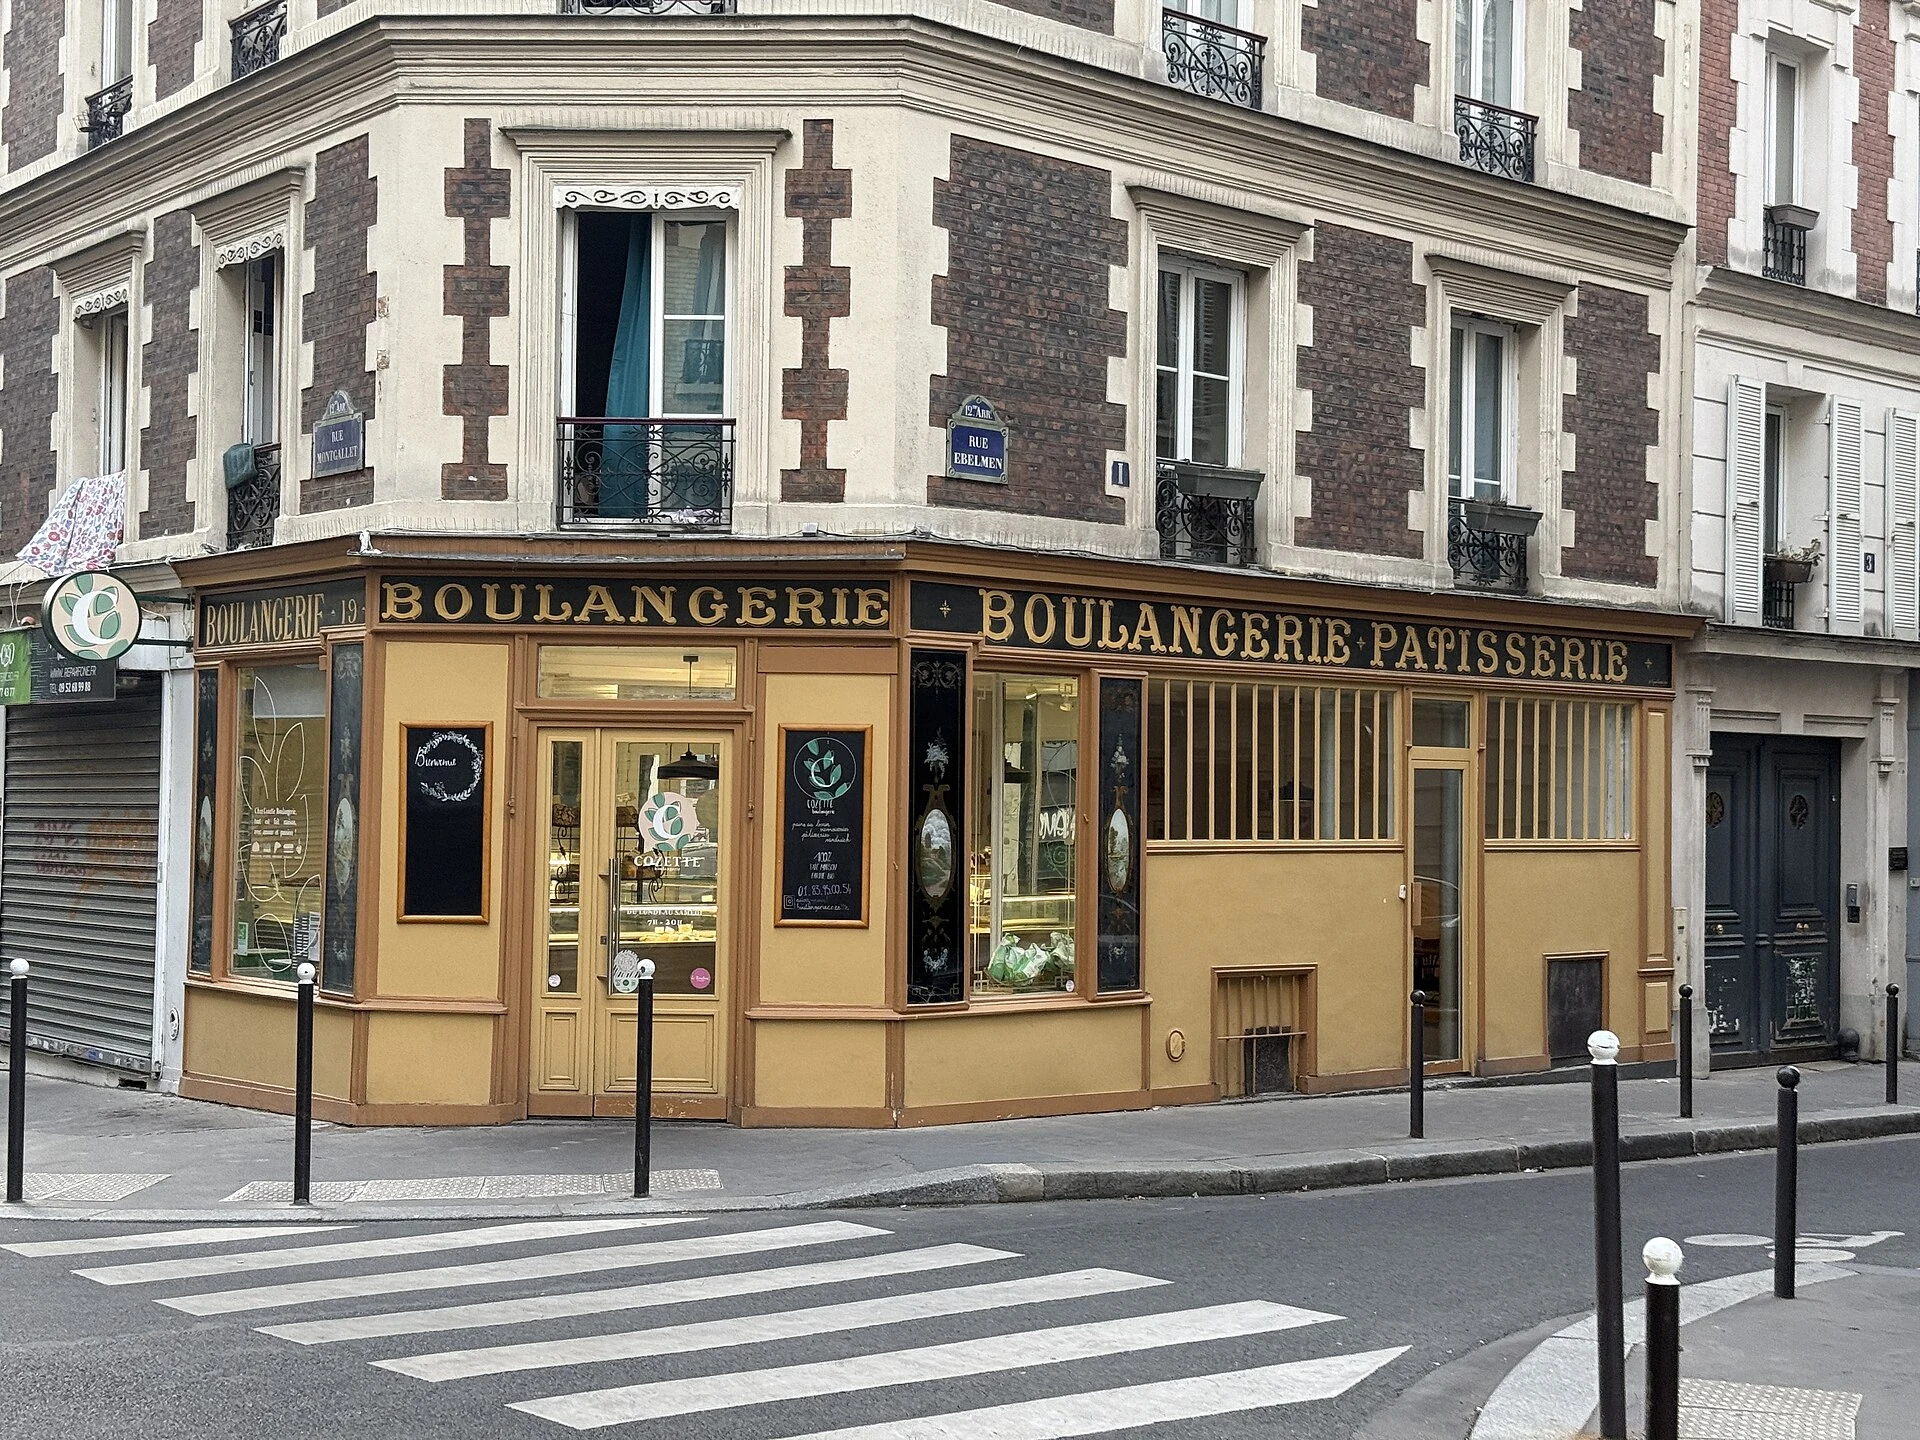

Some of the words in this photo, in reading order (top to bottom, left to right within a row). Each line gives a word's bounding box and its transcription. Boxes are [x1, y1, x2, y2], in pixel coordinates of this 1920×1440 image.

[332, 430, 344, 443] RUE
[968, 435, 988, 450] RUE
[316, 446, 358, 464] MONTGALLET
[954, 452, 1002, 470] EBELMEN
[1866, 555, 1872, 570] 3
[382, 582, 890, 626] BOULANGERIE
[206, 594, 325, 646] BOULANGERIE
[341, 598, 358, 624] 19
[978, 588, 1351, 666] BOULANGERIE
[1370, 622, 1628, 684] PATISSERIE
[65, 682, 71, 692] 52
[634, 856, 704, 868] COZETTE
